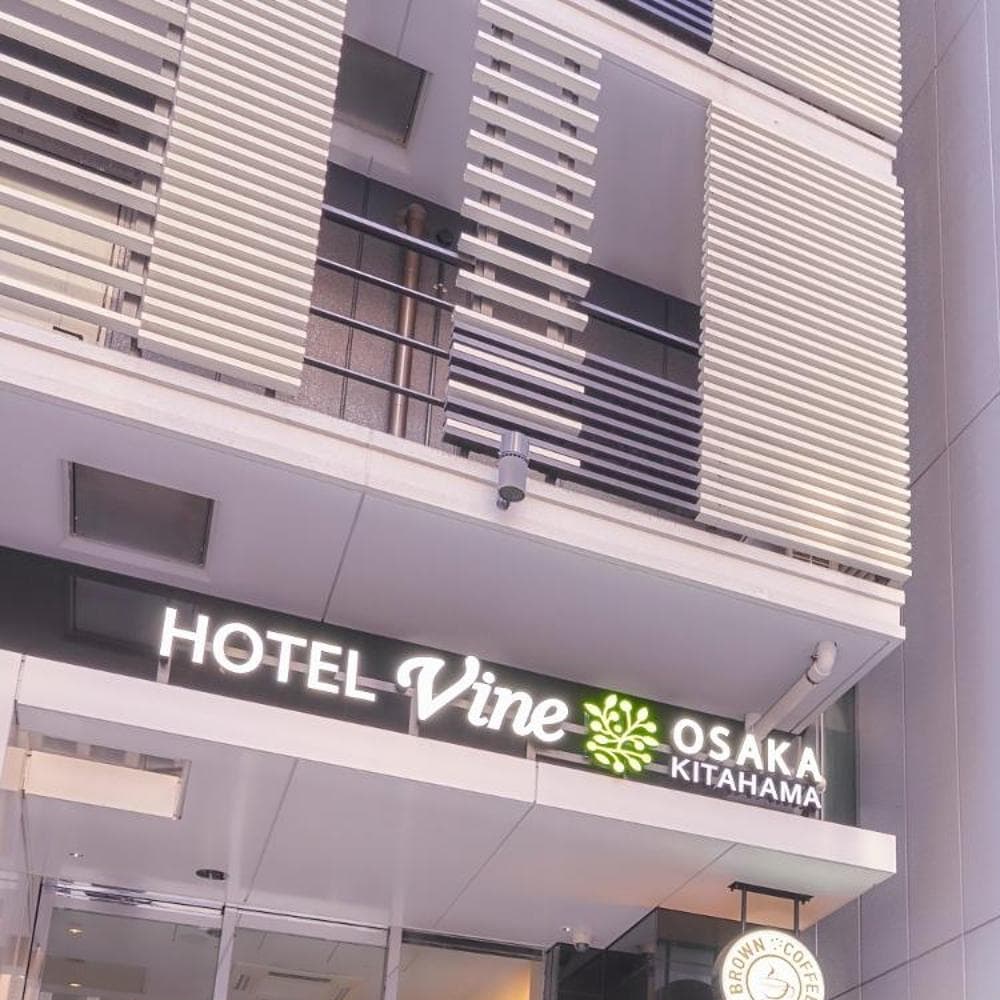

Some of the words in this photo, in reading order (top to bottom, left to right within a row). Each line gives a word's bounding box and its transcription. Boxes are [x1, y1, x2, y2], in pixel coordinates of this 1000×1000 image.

[158, 607, 377, 702] HOTEL
[396, 655, 569, 743] Vine
[671, 718, 823, 782] OSAKA
[670, 756, 823, 809] KITAHAMA
[728, 937, 766, 995] BROWN
